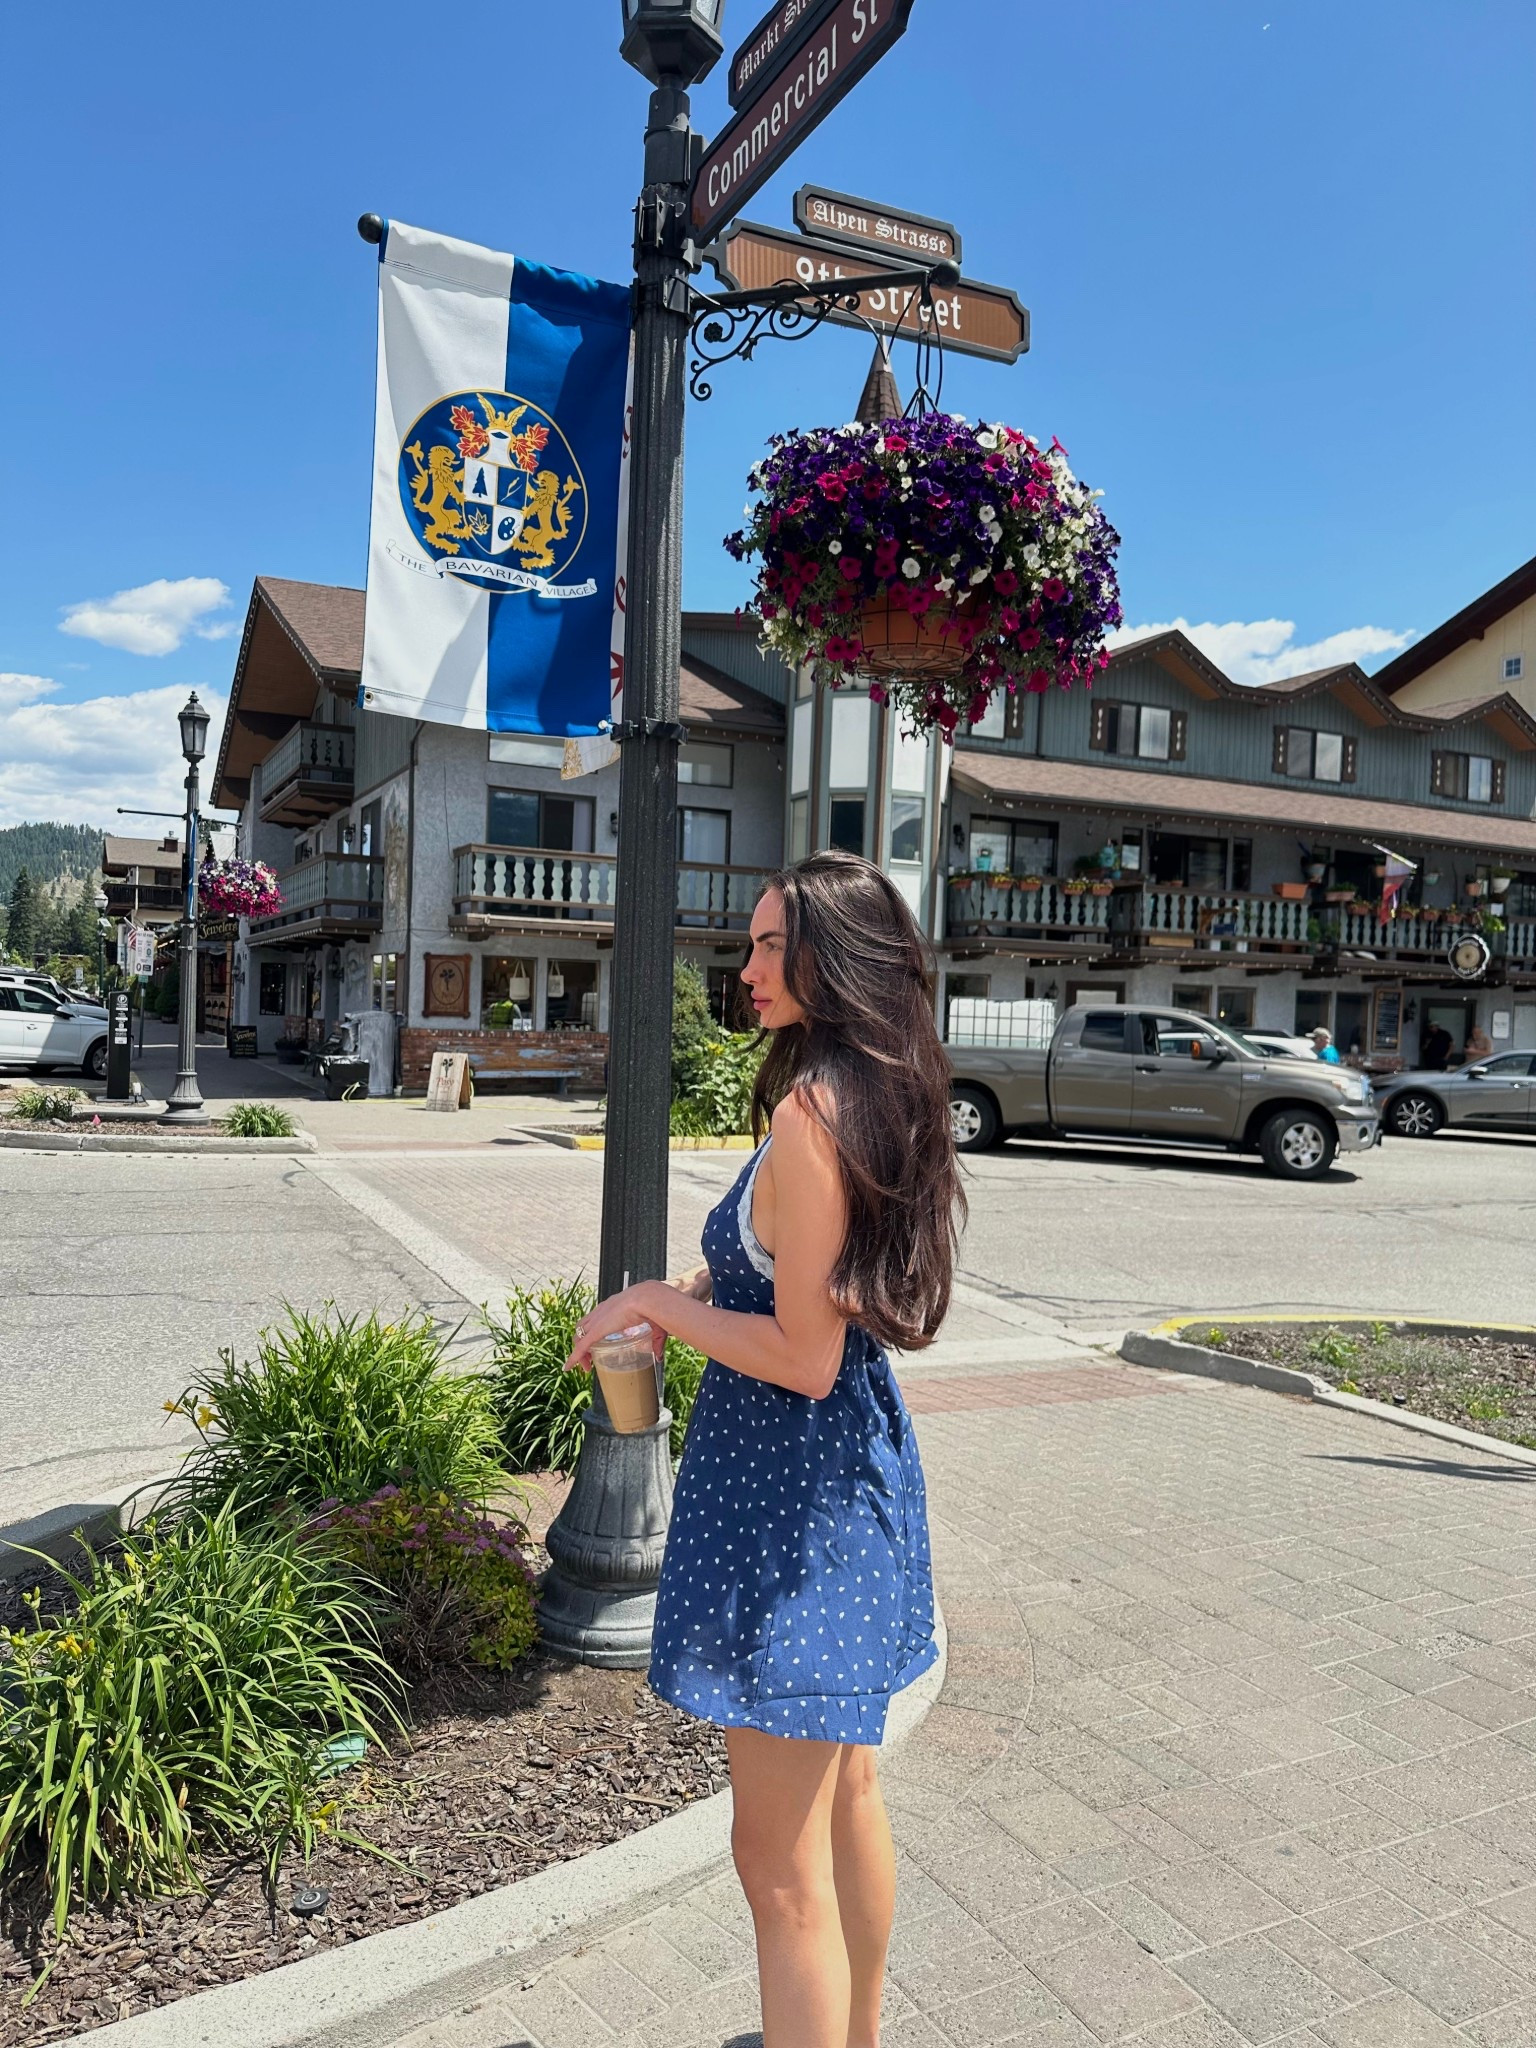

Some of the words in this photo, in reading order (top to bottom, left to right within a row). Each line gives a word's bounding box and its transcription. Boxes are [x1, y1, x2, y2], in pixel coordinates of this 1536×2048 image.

[738, 22, 780, 92] Markt
[707, 23, 838, 208] Commercial
[812, 200, 868, 233] Alpen
[875, 218, 947, 254] Strasse
[868, 286, 962, 330] Street
[399, 554, 427, 573] THE
[445, 560, 538, 587] BAVARIAN
[545, 586, 591, 597] VILLAGE
[198, 921, 238, 940] Jewelers
